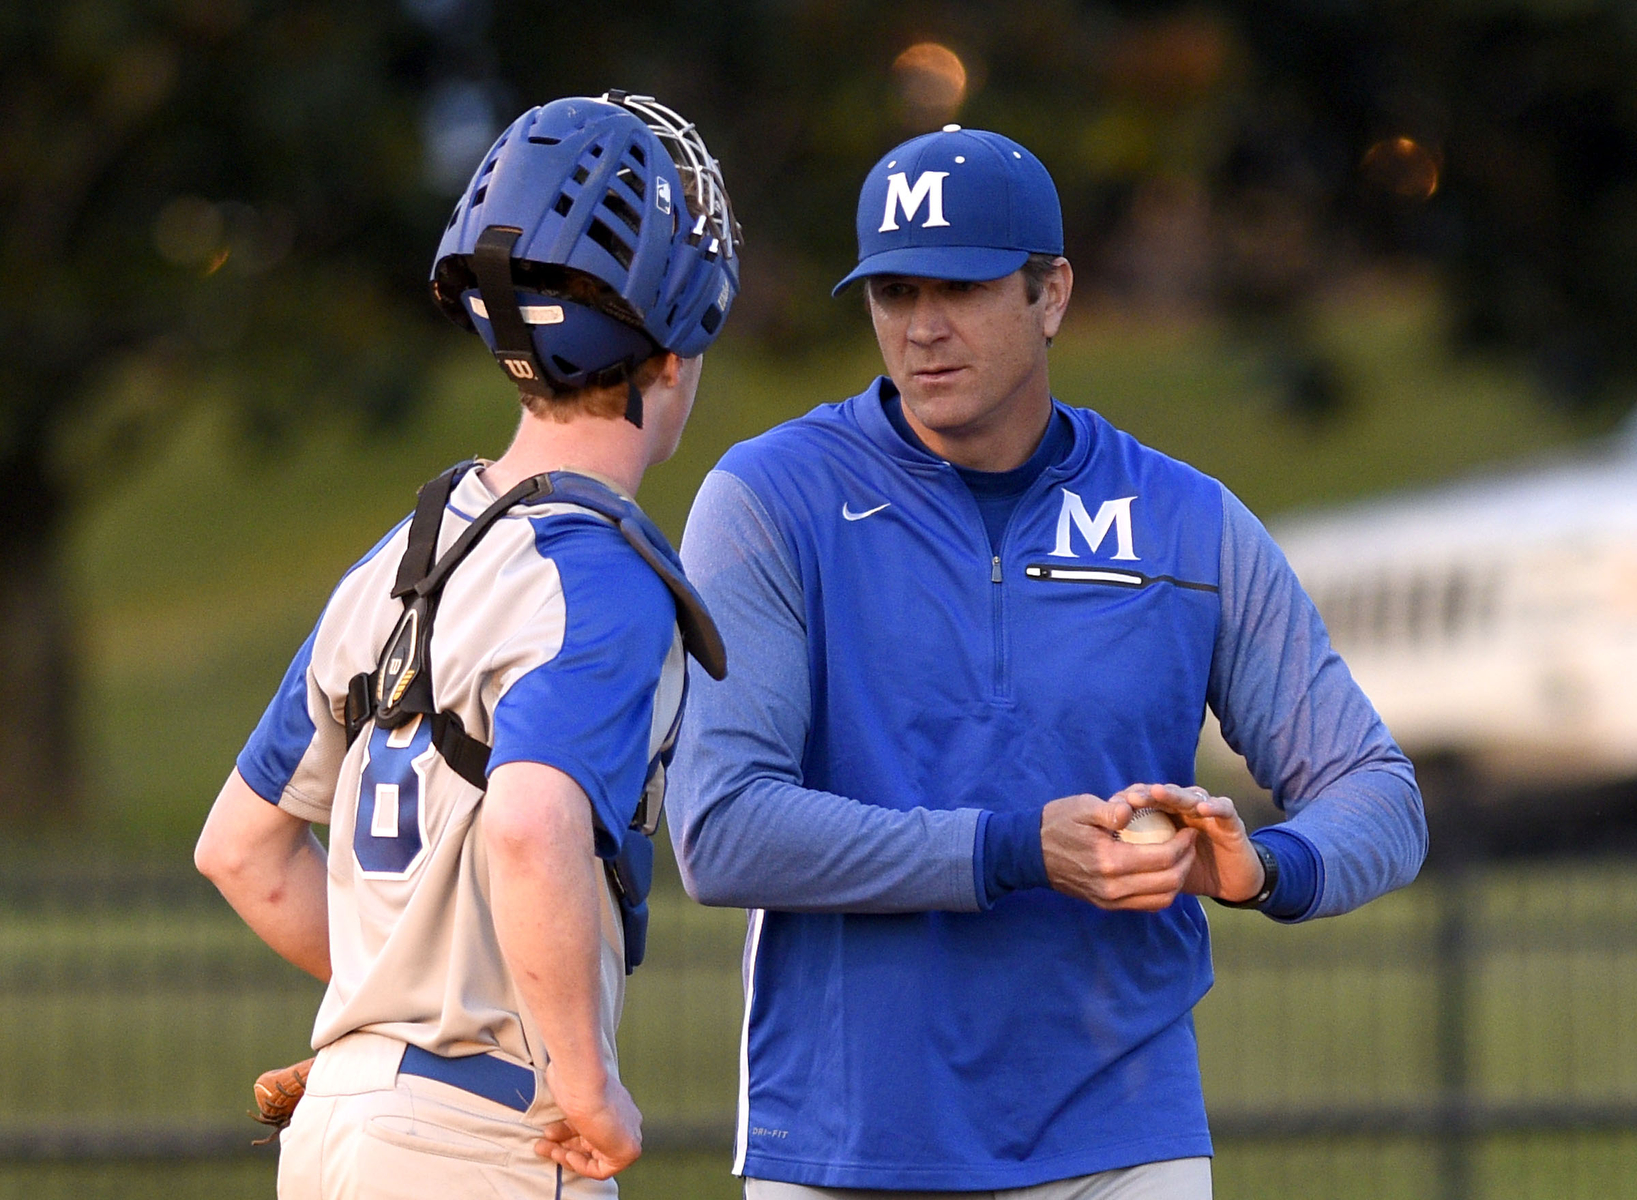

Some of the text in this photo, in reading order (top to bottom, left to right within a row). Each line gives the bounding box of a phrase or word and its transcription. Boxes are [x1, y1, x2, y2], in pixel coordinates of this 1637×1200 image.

[878, 170, 950, 233] M
[1047, 488, 1142, 561] M
[352, 713, 437, 881] 8
[752, 1127, 789, 1139] DRI-FIT
